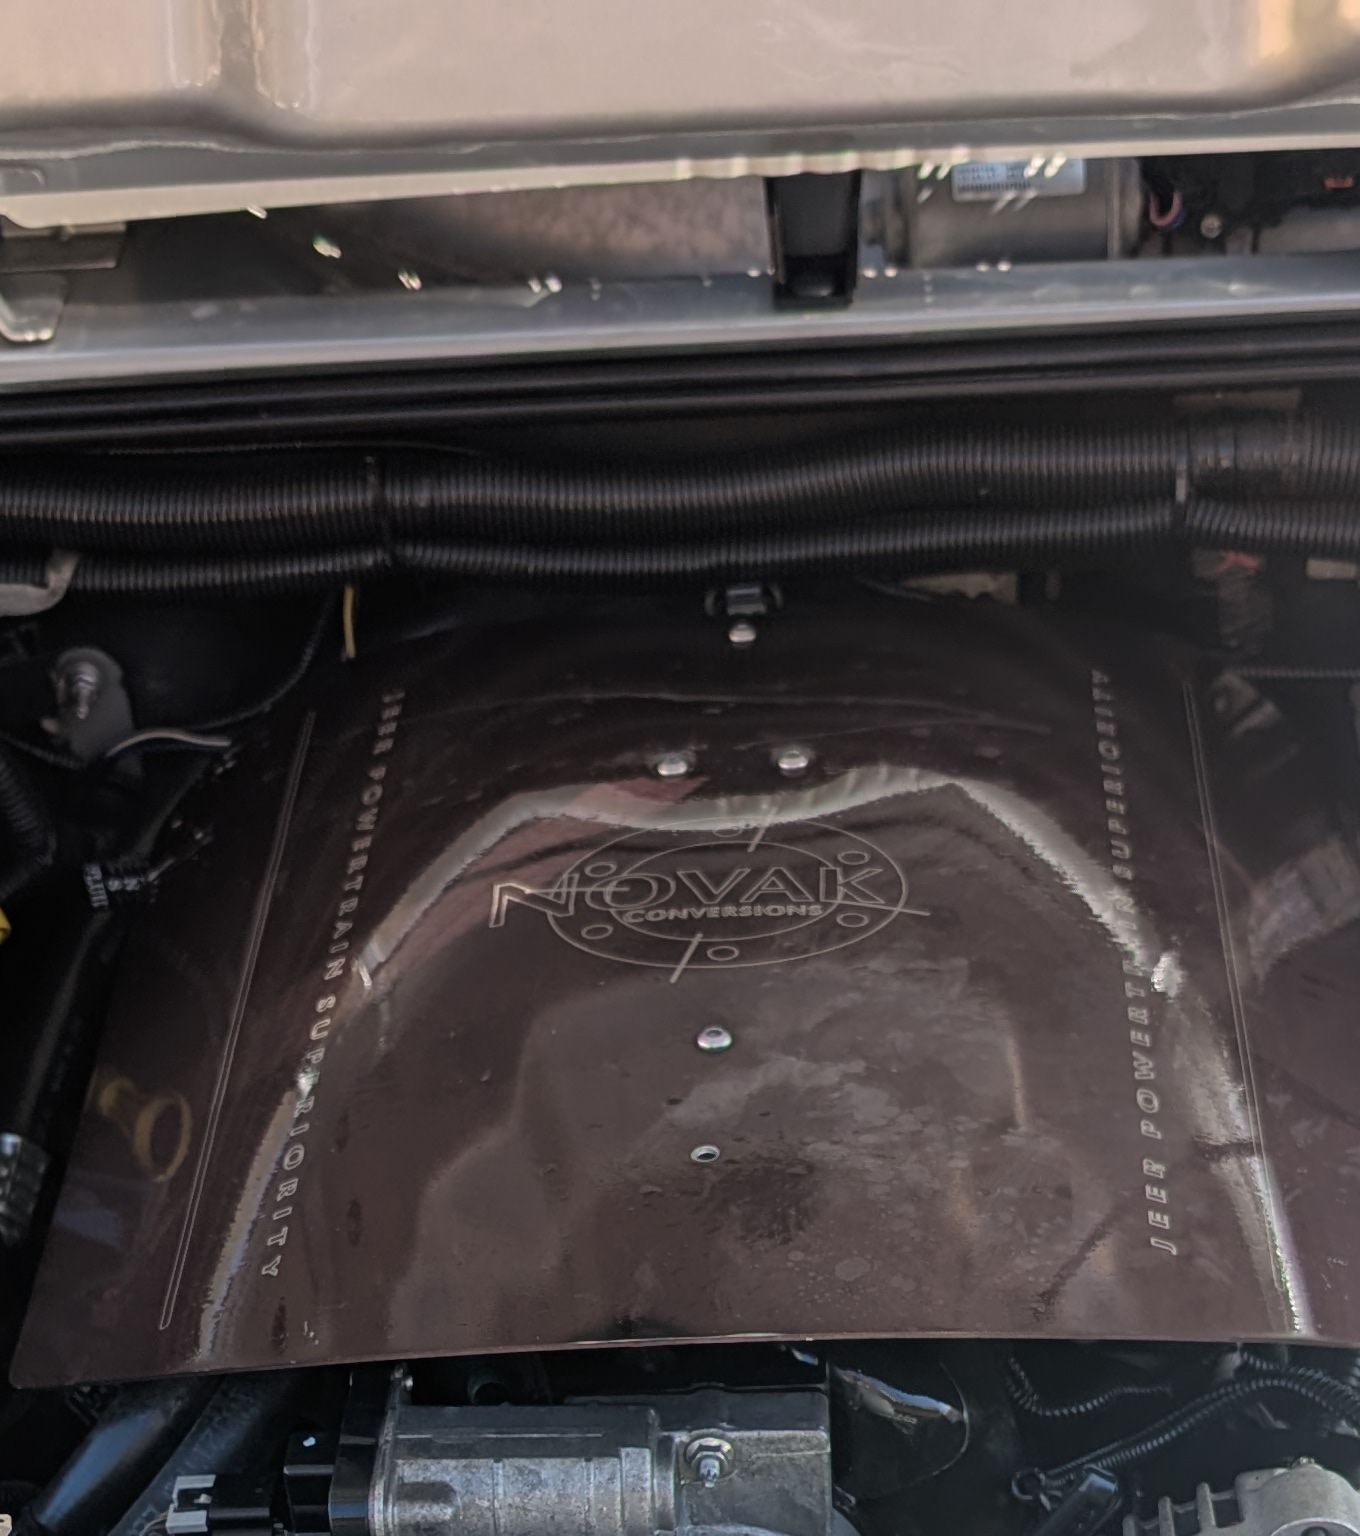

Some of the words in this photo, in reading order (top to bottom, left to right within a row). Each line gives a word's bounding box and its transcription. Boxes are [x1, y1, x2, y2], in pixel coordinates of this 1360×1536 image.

[323, 764, 387, 981] POWERTRAIN
[489, 866, 886, 928] NOVAK
[623, 902, 824, 921] CONVERSIONS
